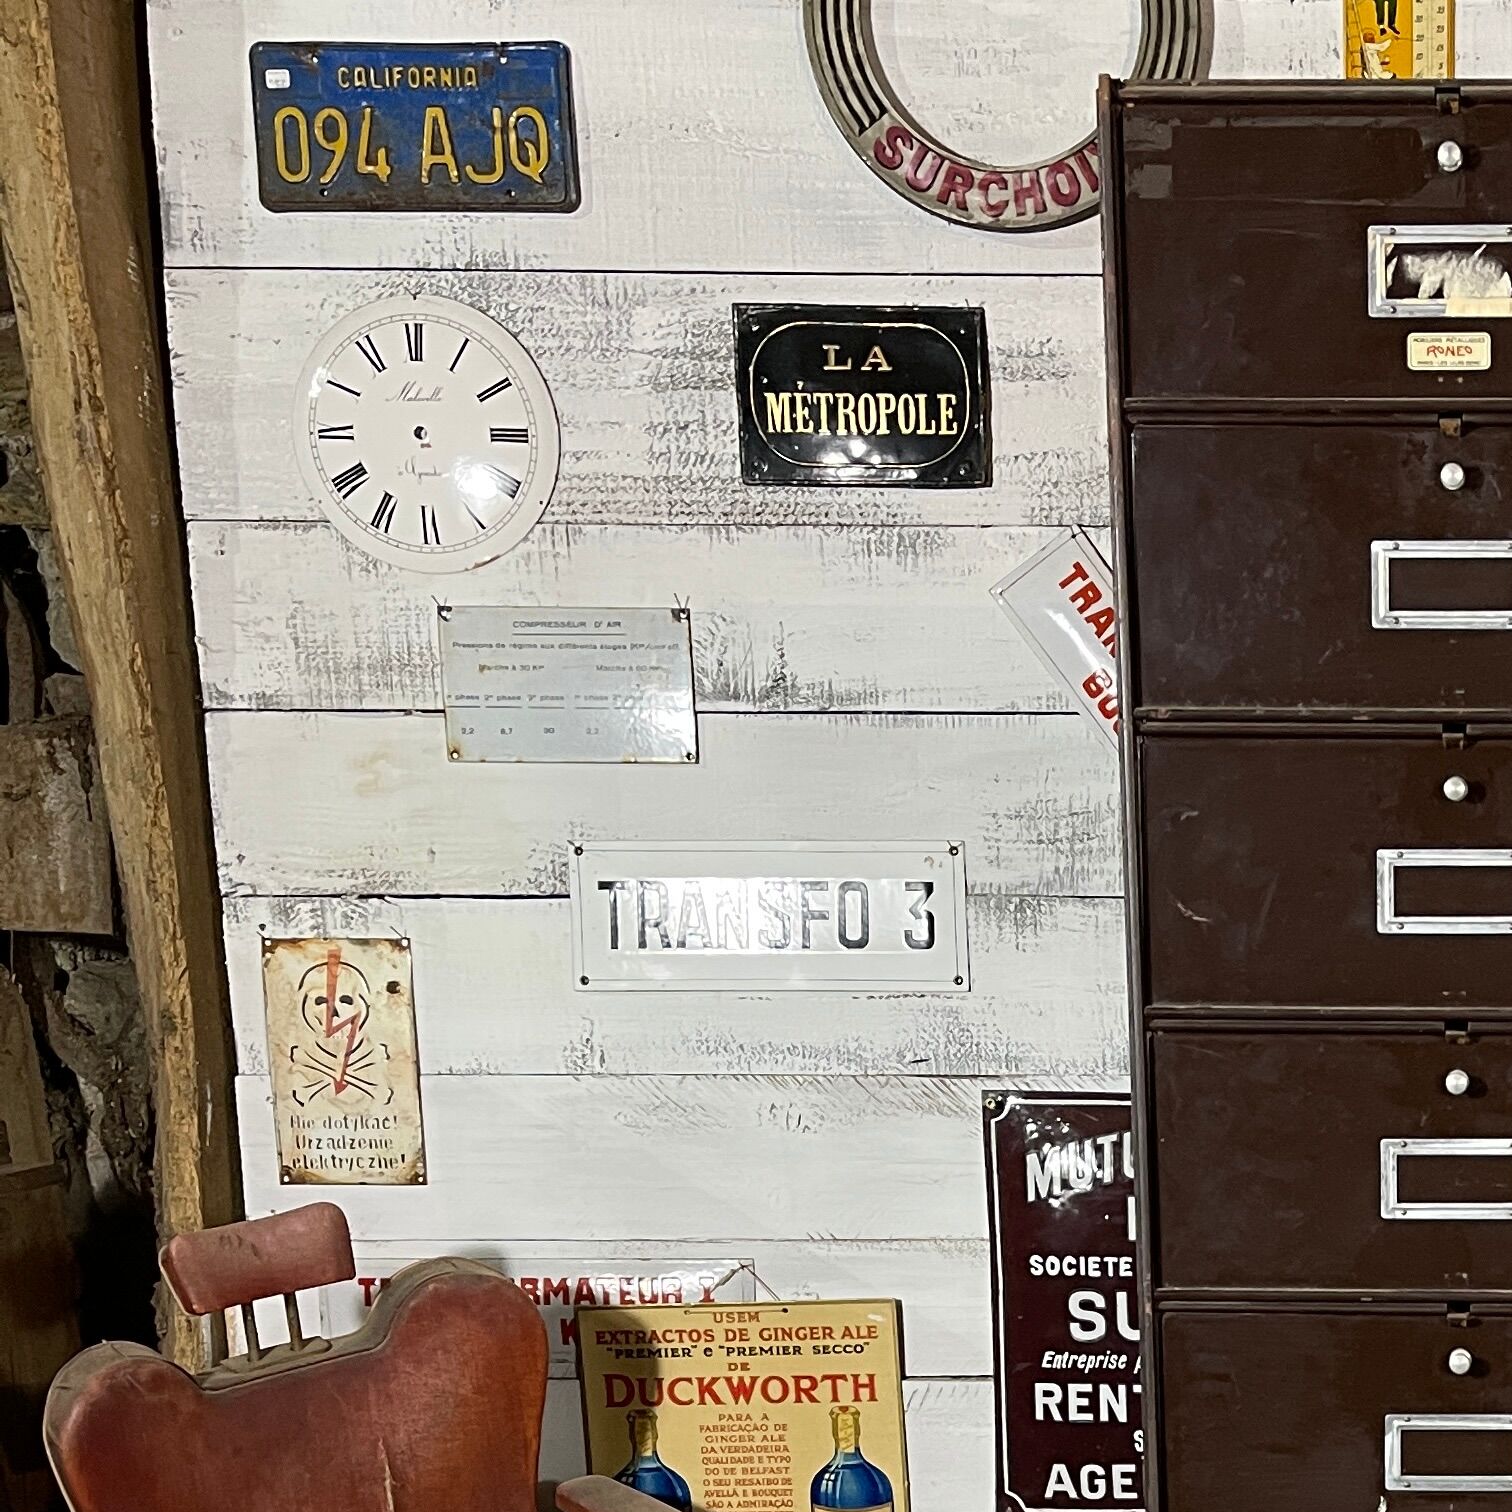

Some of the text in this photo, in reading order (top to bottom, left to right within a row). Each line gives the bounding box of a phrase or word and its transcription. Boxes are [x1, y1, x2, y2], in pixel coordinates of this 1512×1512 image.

[337, 66, 479, 89] CALIFORNIA
[273, 106, 550, 184] 094 AJQ
[873, 125, 1100, 218] SURCHOI
[822, 343, 893, 371] LA
[1426, 345, 1472, 358] RONEO
[764, 381, 958, 436] MÉTROPOLE
[597, 880, 935, 950] TRANSFO 3
[1029, 1255, 1133, 1277] SOCIETE
[713, 1311, 760, 1323] USEM
[596, 1325, 879, 1345] EXTRACTOS DE GINGER ALE
[728, 1362, 751, 1372] DE
[1041, 1350, 1128, 1374] Entreprise
[718, 1412, 770, 1421] PARA A
[699, 1422, 788, 1434] FABRICAÇÃO DE
[704, 1434, 786, 1443] GINGER ALE
[701, 1444, 790, 1454] DA VERDADEIRA
[701, 1455, 755, 1465] QUALIDADE
[766, 1455, 792, 1464] TYPO
[704, 1467, 720, 1476] DO
[741, 1466, 790, 1475] BELFAST
[713, 1478, 731, 1487] SEU
[752, 1489, 794, 1498] BOUQUET
